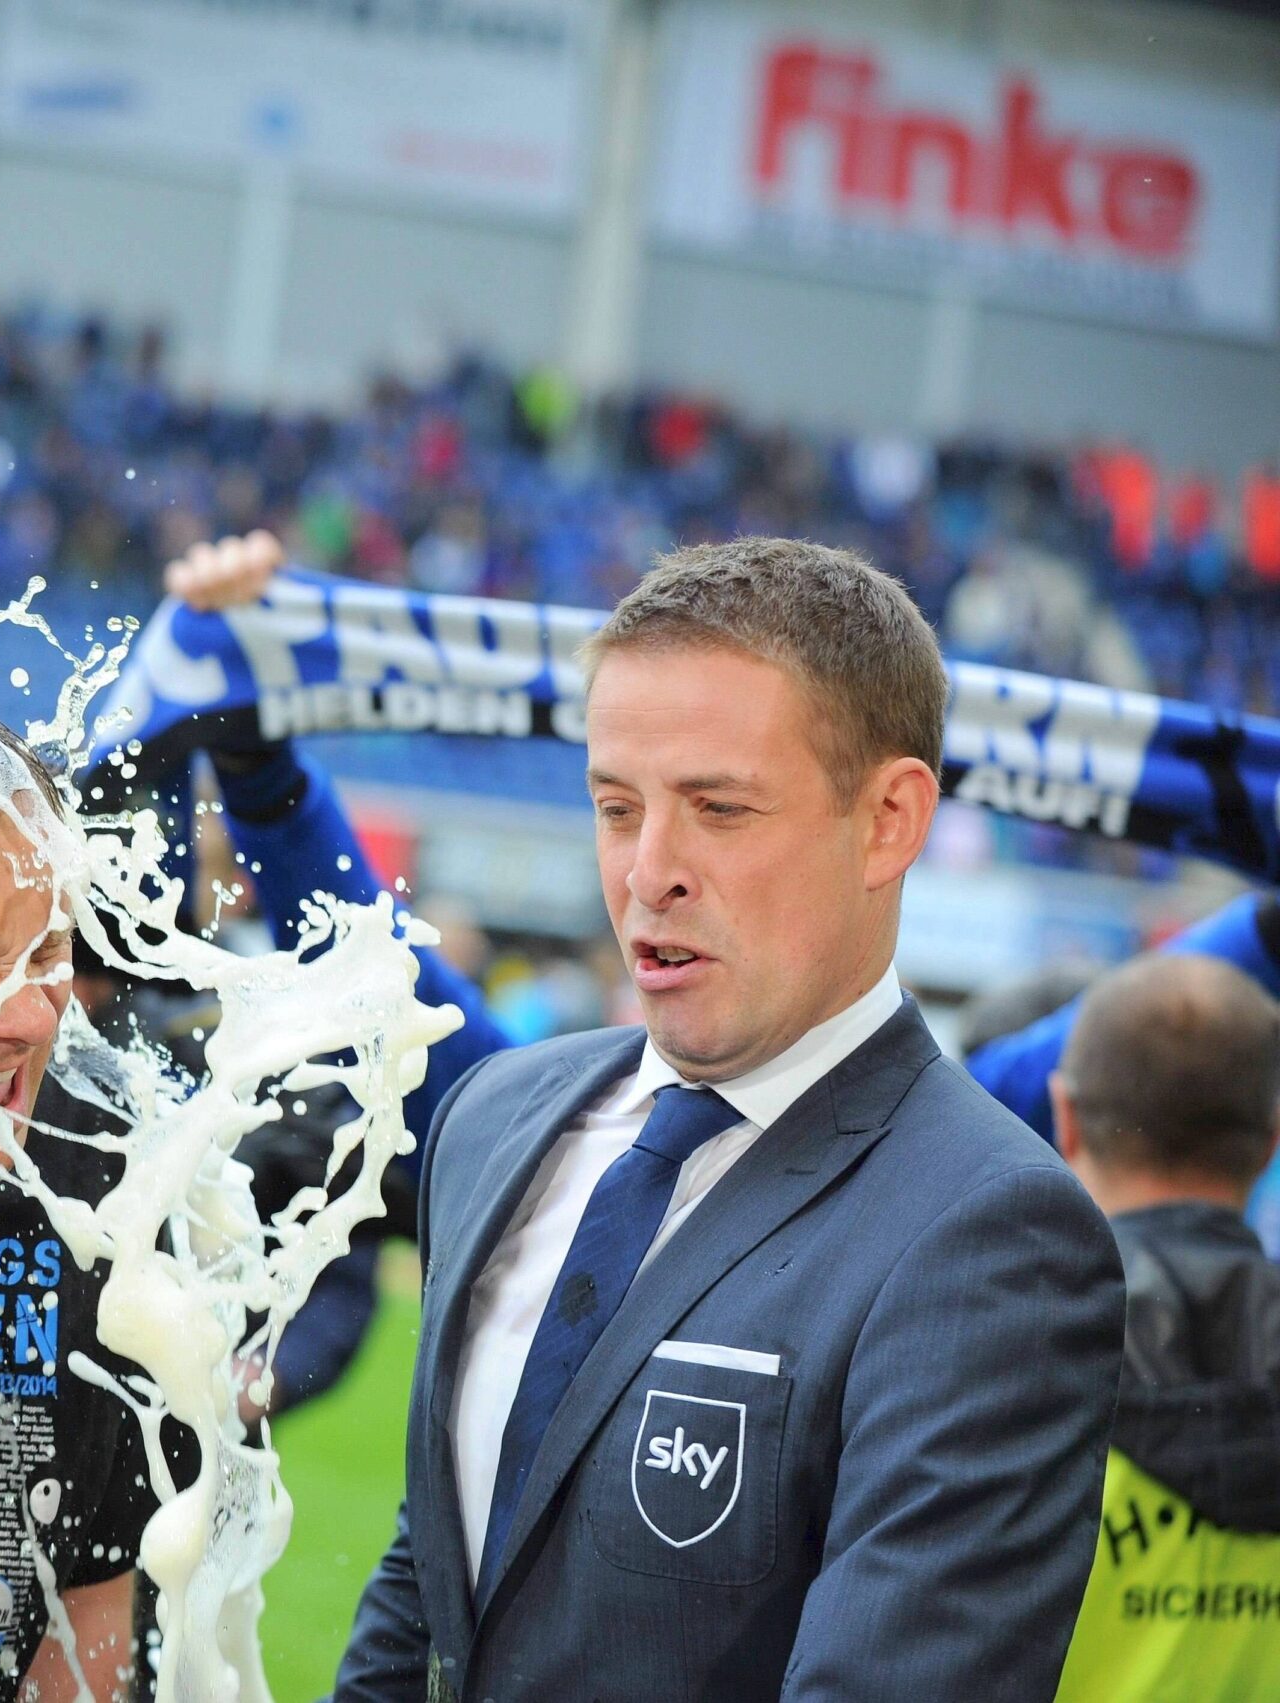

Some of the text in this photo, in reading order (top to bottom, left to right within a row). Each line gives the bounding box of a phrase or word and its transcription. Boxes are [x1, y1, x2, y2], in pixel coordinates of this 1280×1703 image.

[754, 42, 1197, 260] finke
[257, 680, 533, 742] HELDEN
[645, 1426, 729, 1490] sky
